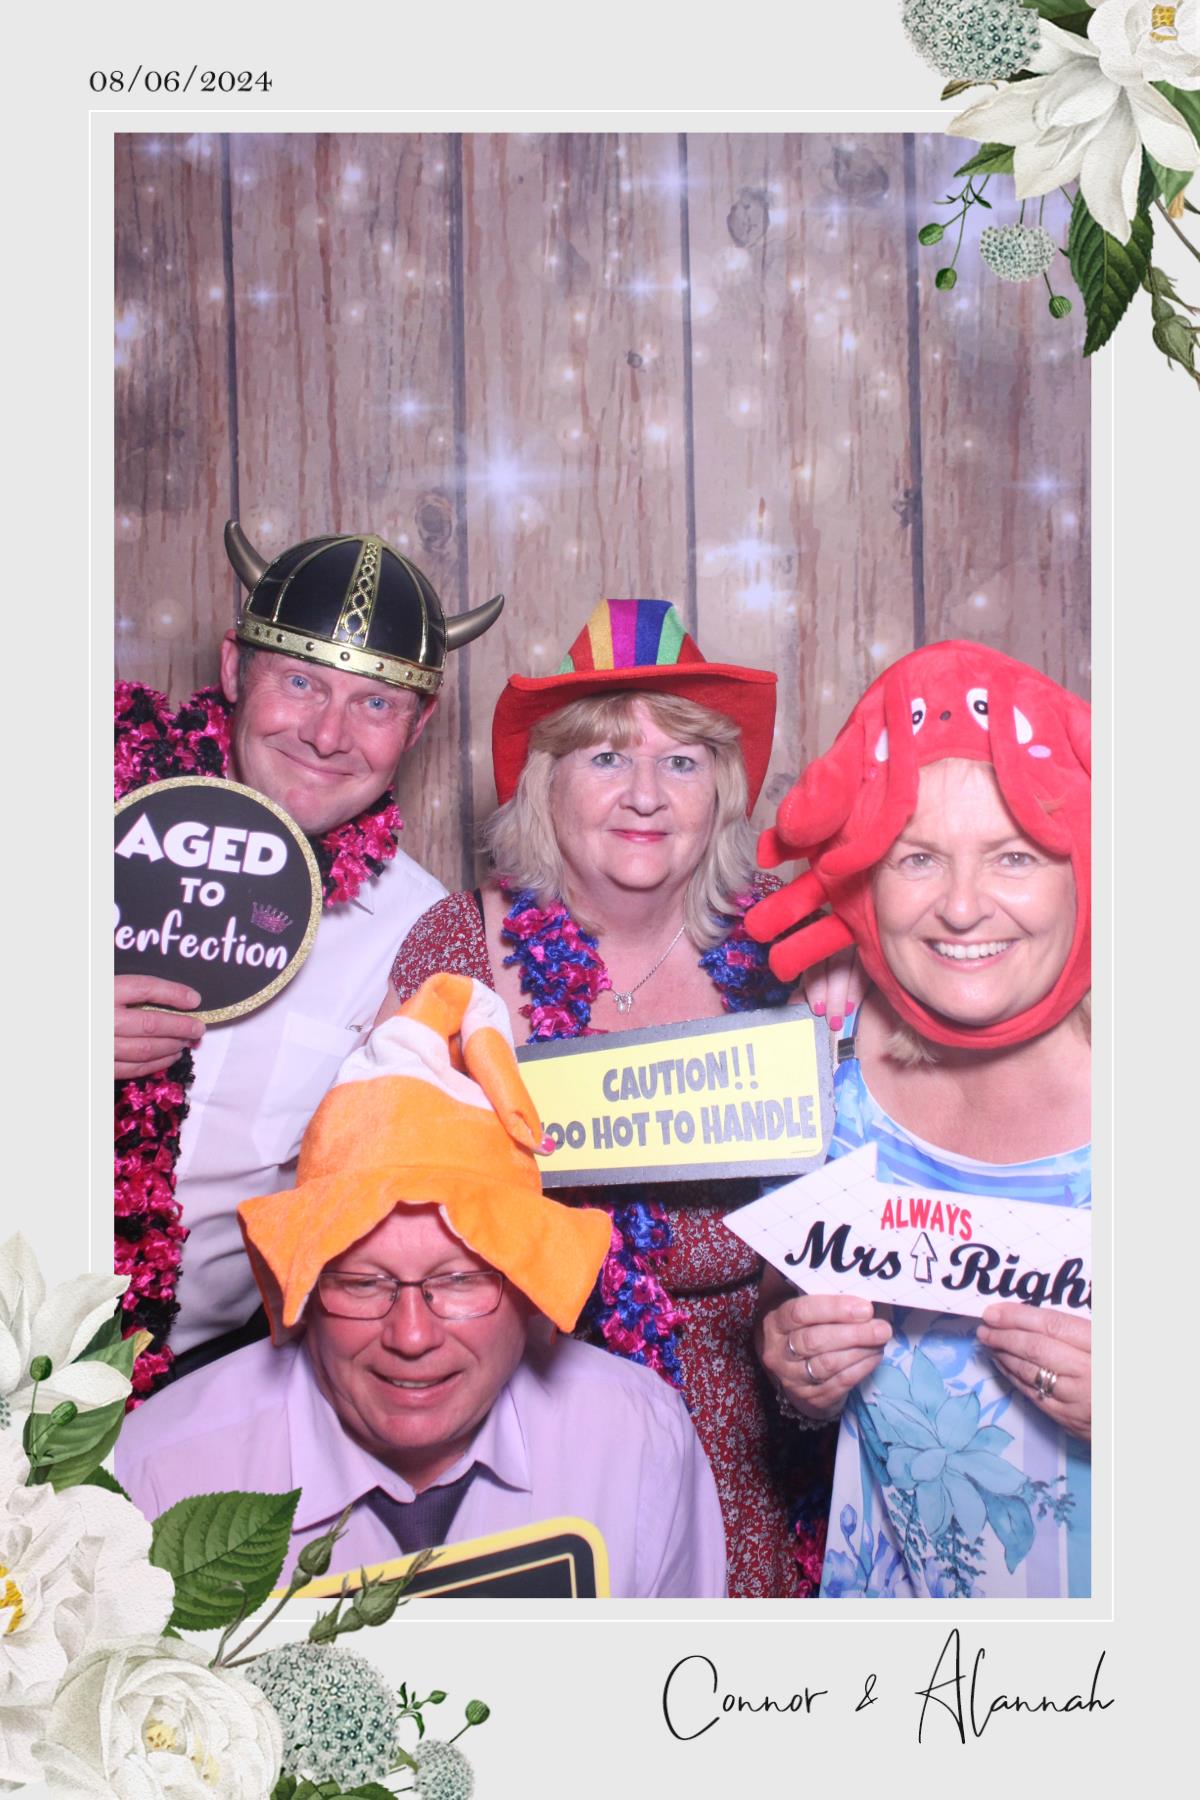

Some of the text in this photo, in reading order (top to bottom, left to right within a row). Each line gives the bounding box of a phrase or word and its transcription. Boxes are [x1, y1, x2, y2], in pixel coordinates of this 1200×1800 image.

[114, 812, 288, 876] AGED
[181, 877, 226, 907] TO
[114, 902, 288, 970] erfection
[602, 1043, 759, 1102] CAUTION!!
[541, 1095, 817, 1150] OO HOT TO HANDLE
[880, 1197, 973, 1241] ALWAYS
[784, 1220, 1091, 1310] Mrs Righ
